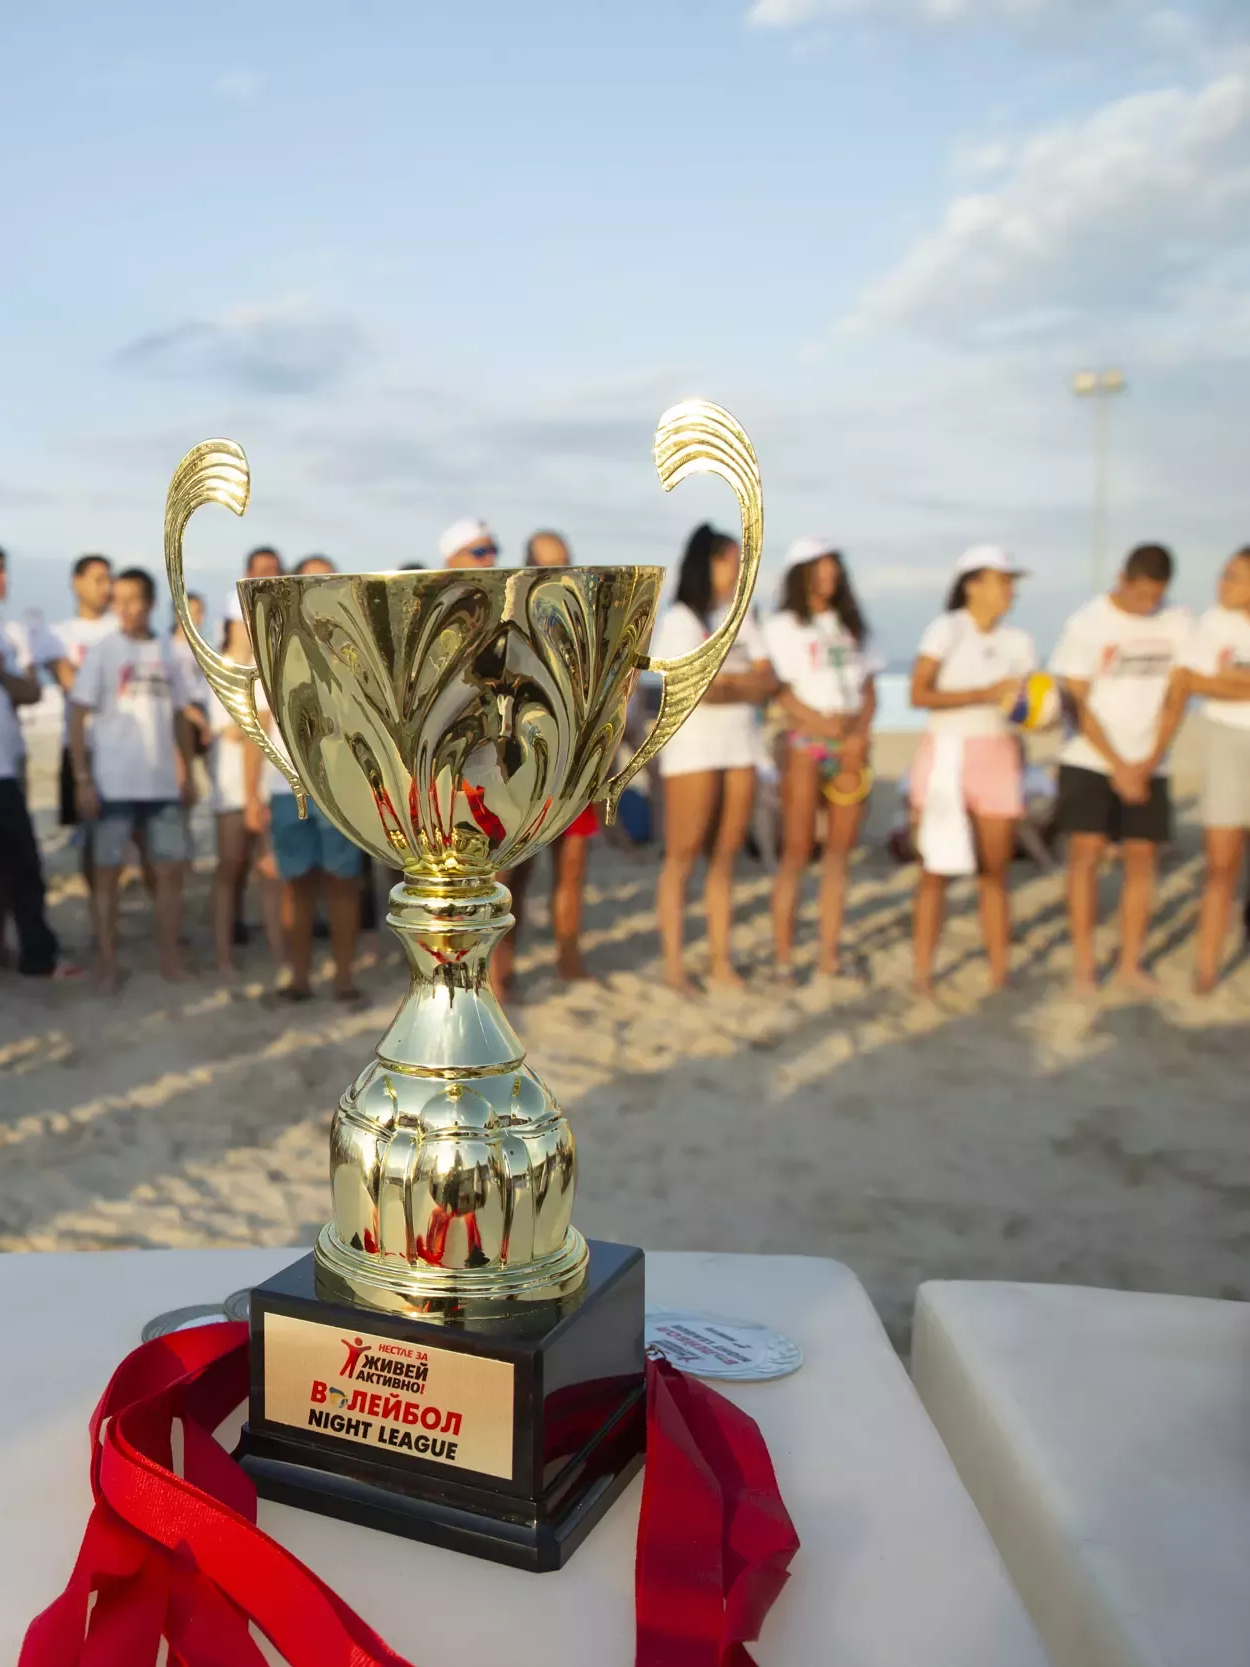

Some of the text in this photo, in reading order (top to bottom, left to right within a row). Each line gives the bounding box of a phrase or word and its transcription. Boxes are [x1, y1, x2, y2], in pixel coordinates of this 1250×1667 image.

[378, 1343, 428, 1361] НЕСТЛЕ ЗА
[361, 1354, 429, 1382] ЖИВЕЙ
[355, 1369, 425, 1395] АКТИВНО!
[308, 1408, 458, 1461] NIGHT LEAGUE
